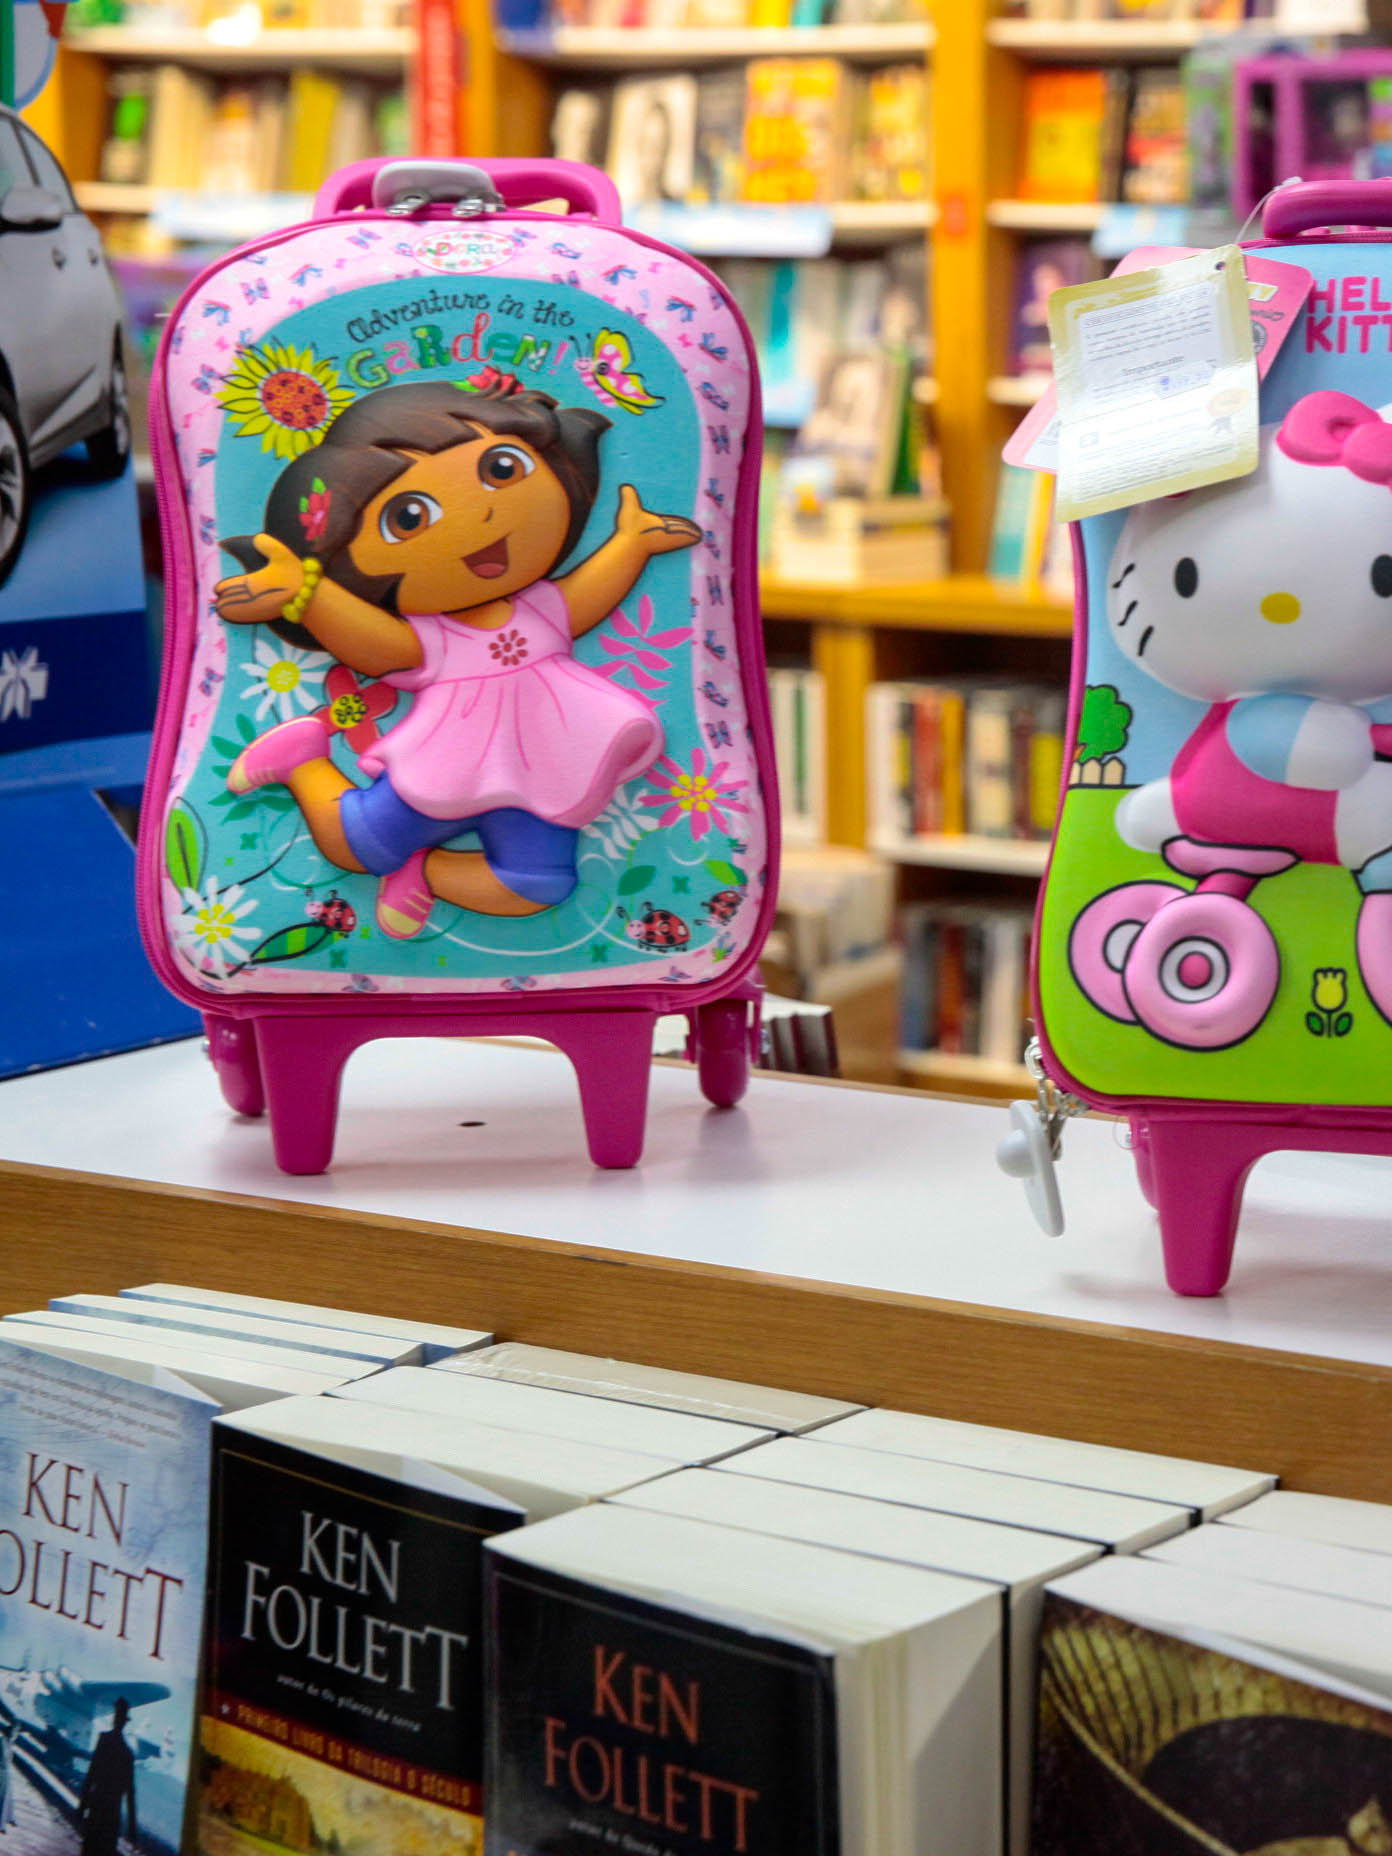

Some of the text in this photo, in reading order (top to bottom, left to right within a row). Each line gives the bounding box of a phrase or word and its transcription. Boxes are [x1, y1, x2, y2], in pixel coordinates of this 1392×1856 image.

[496, 294, 526, 320] in
[532, 299, 576, 327] the
[22, 1451, 130, 1548] KEN
[0, 1529, 184, 1661] OLLETT
[300, 1510, 401, 1604] KEN
[240, 1560, 469, 1711] FOLLETT
[593, 1644, 701, 1745] KEN
[543, 1716, 760, 1852] FOLLETT
